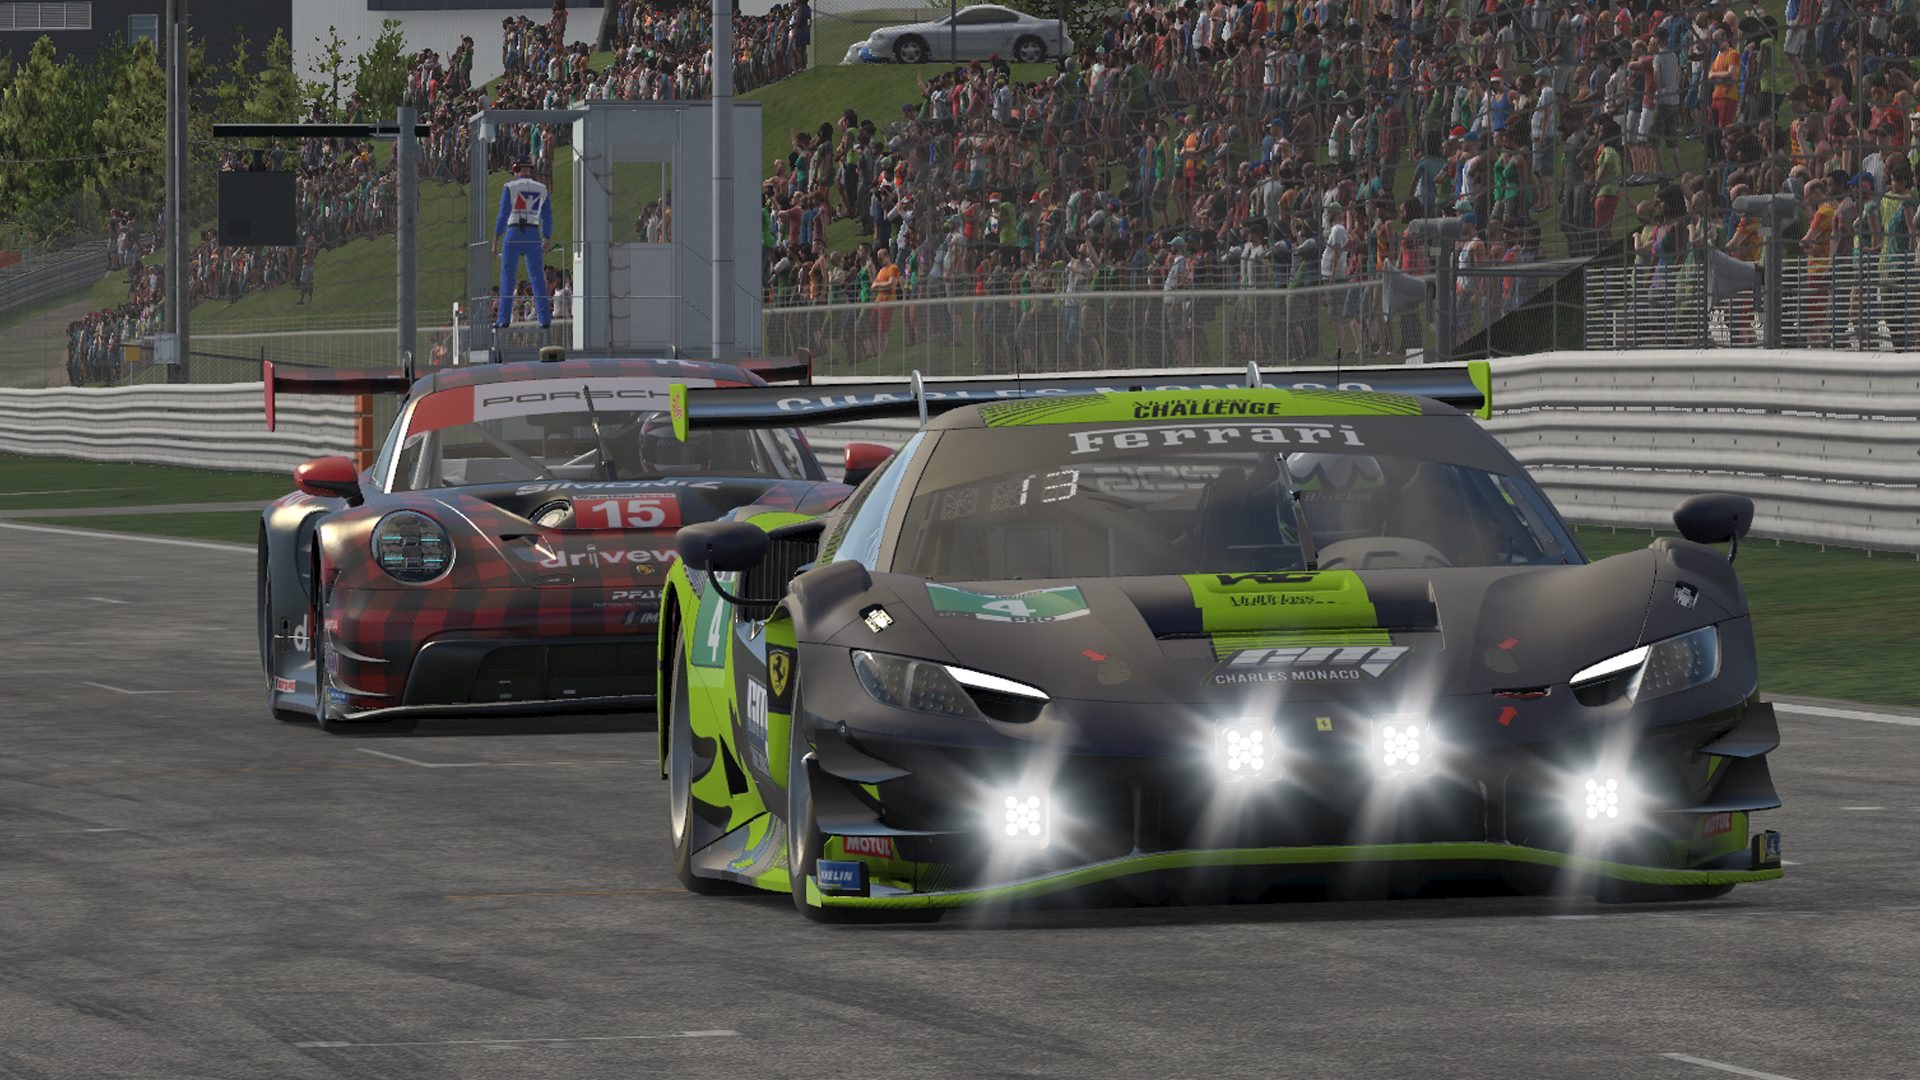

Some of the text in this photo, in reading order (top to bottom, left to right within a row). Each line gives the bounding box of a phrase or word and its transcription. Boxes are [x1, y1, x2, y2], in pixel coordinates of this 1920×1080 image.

[1133, 402, 1281, 418] CHALLENGE
[1068, 422, 1365, 454] Ferrari
[515, 480, 723, 496] SIMONIZ
[592, 500, 665, 528] 15
[982, 600, 1037, 617] 4
[707, 588, 724, 662] 4
[1215, 669, 1360, 685] CHARLES MONACO
[845, 836, 892, 855] MOTUL
